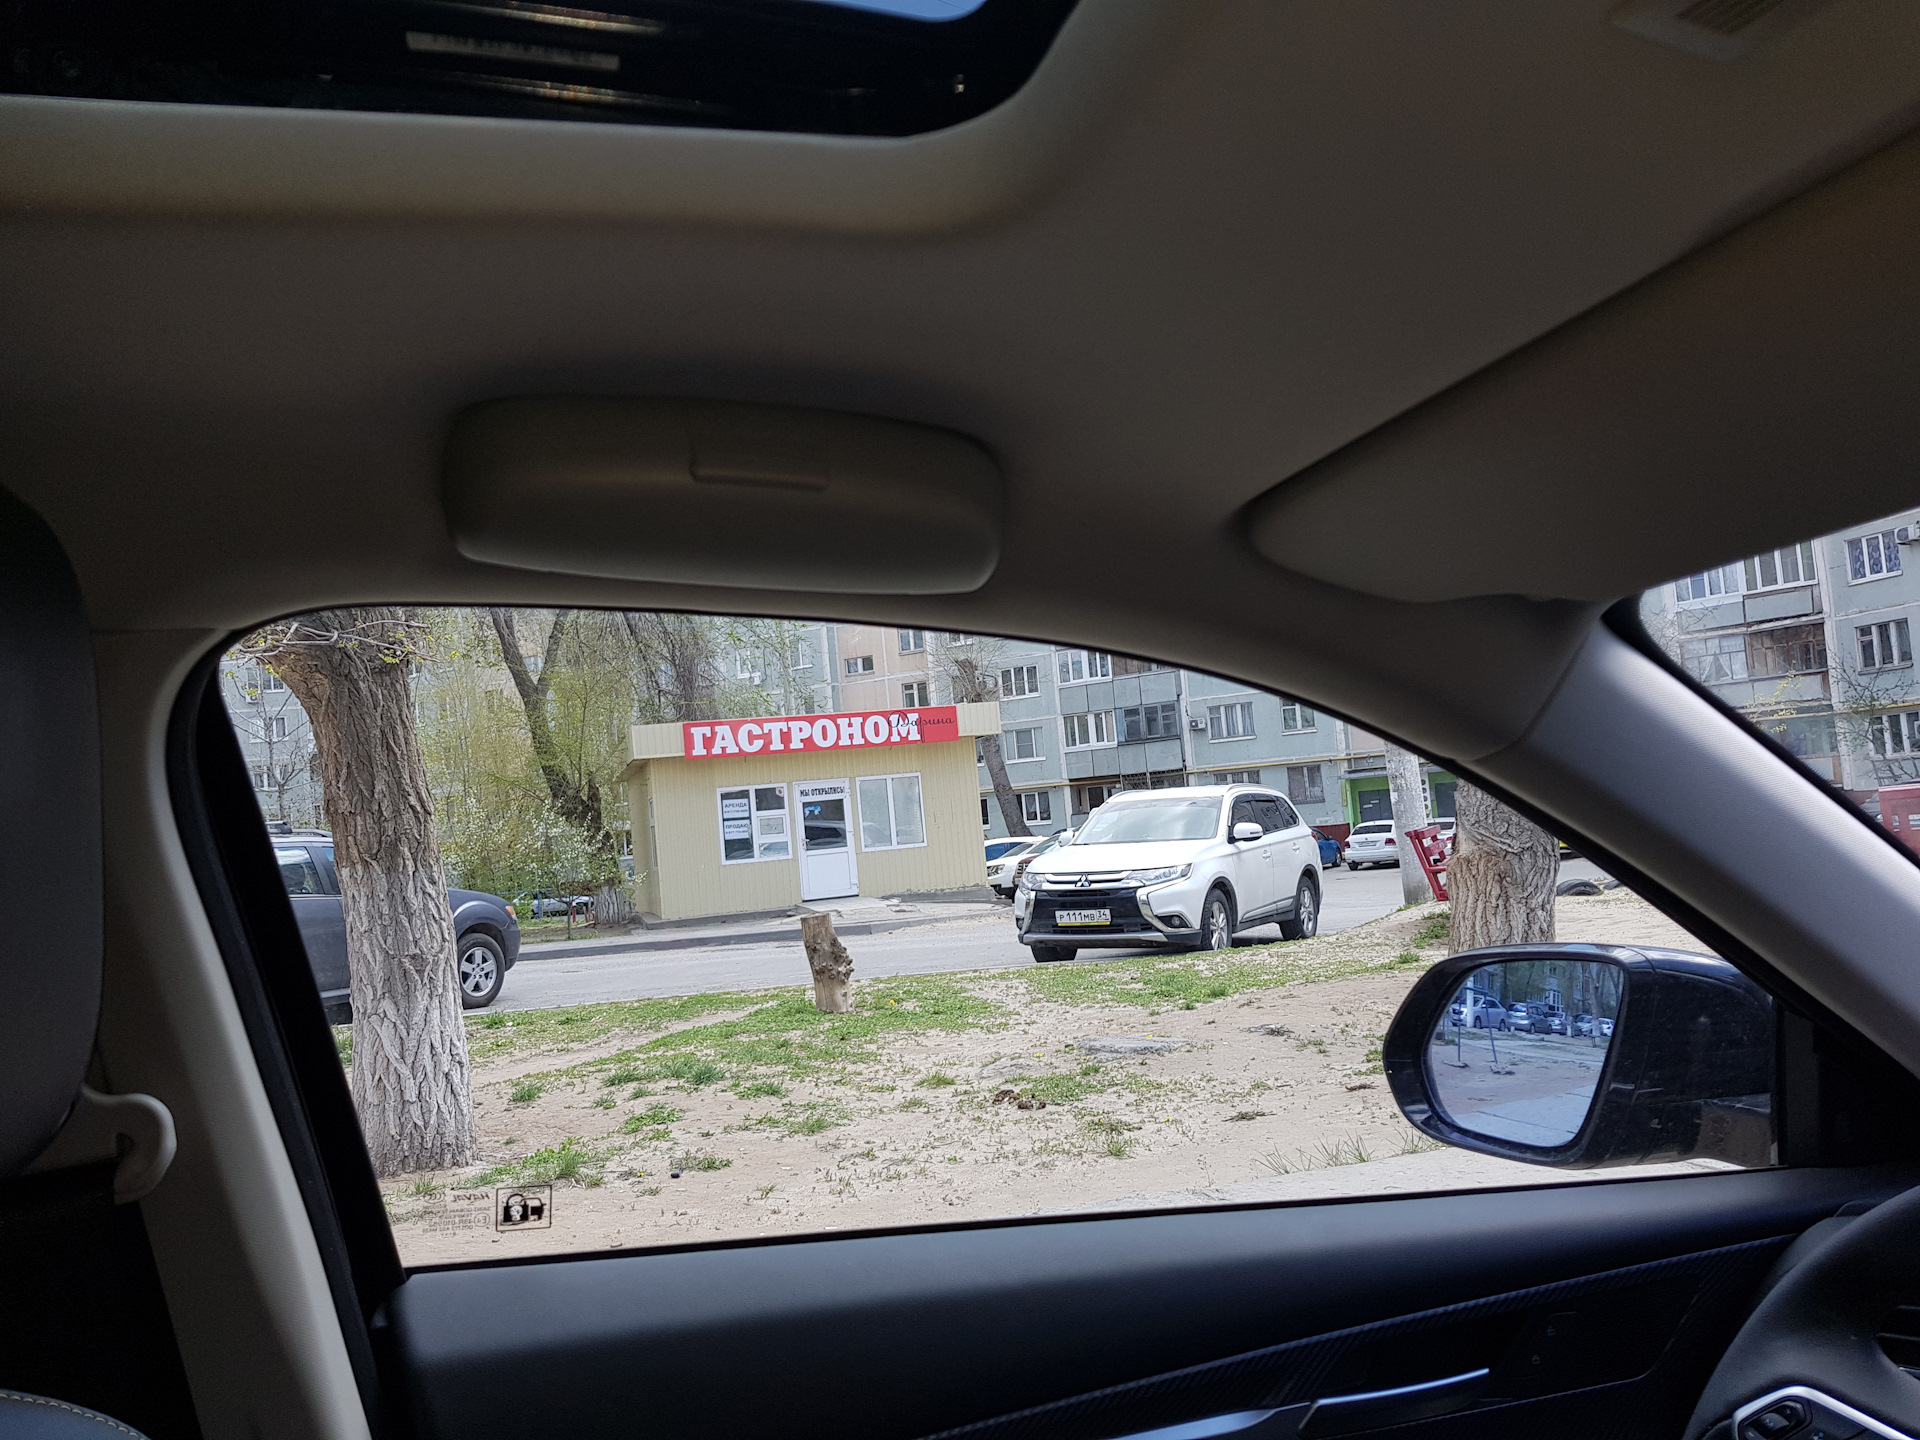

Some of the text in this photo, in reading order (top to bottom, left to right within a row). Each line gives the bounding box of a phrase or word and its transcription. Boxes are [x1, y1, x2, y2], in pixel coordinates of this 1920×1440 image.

[690, 712, 921, 757] ГАСТРОНОМ
[799, 789, 811, 798] МЫ
[1097, 910, 1107, 918] 34
